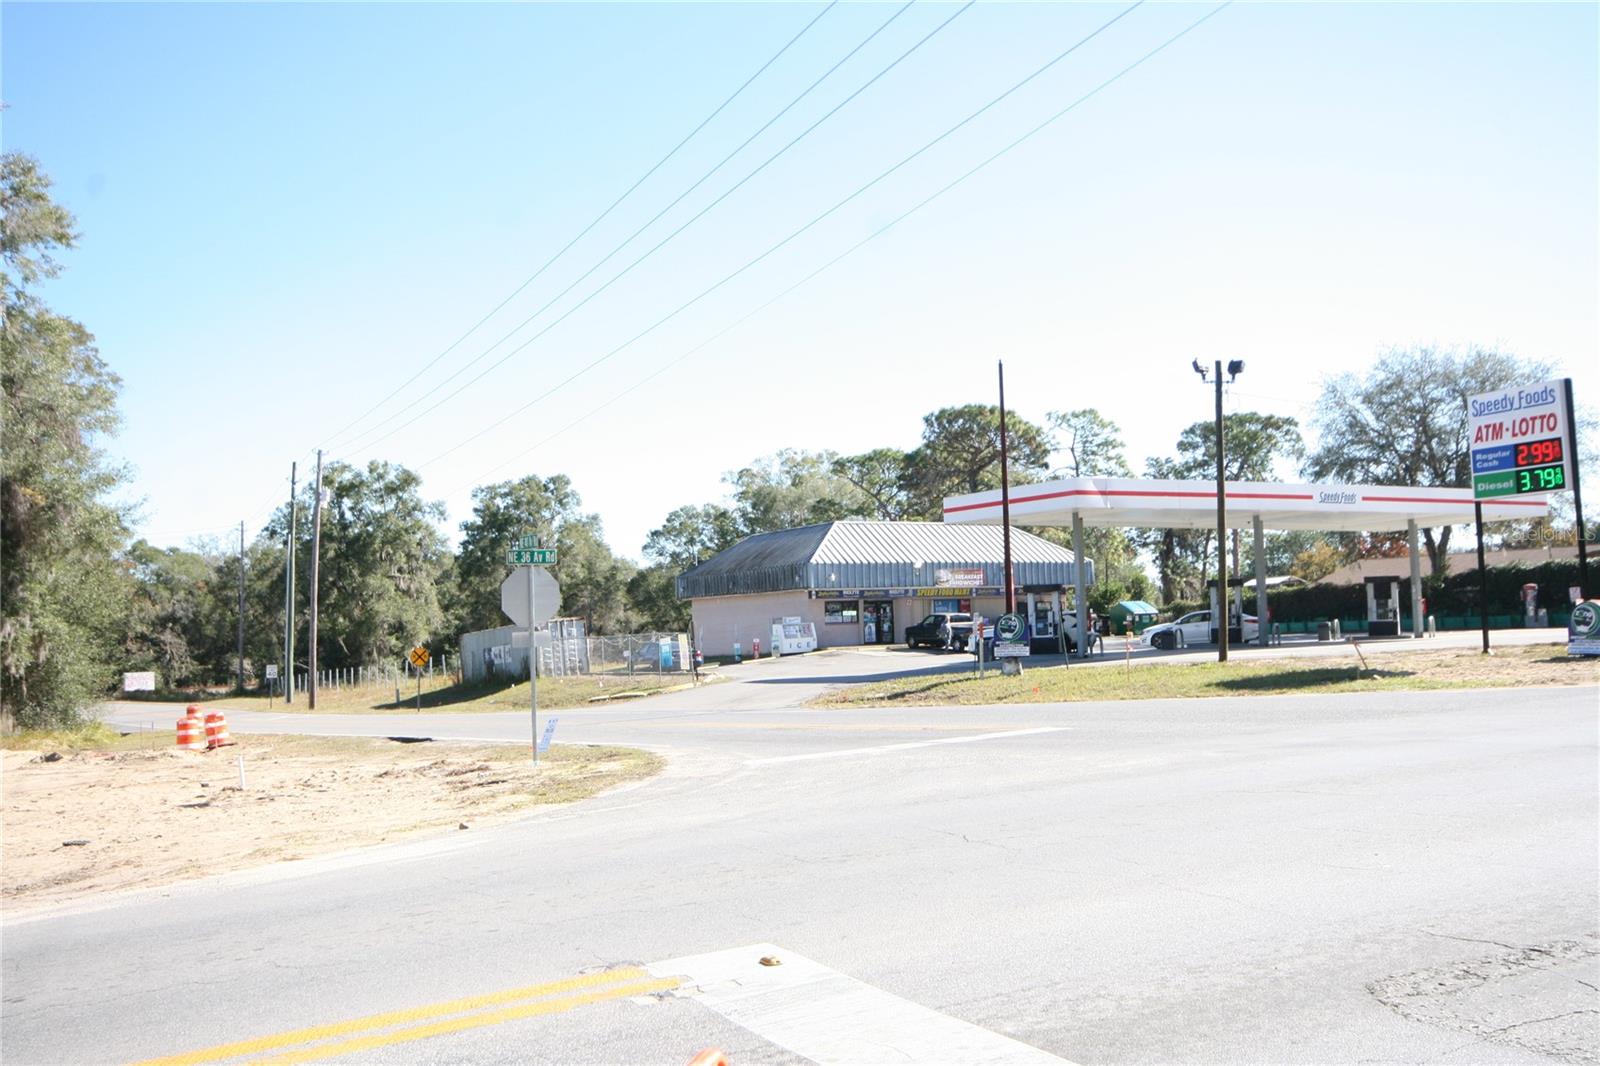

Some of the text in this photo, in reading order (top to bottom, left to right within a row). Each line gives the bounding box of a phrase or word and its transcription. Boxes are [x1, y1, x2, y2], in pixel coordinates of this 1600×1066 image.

[1471, 386, 1556, 417] Speedy Foods
[1474, 413, 1557, 443] ATM LOTTO
[1475, 450, 1511, 460] Regular
[1476, 460, 1499, 469] Cash
[1477, 479, 1514, 491] Diesel
[1319, 491, 1357, 504] Speedy Foods
[508, 551, 518, 563] NE
[520, 551, 531, 563] 36
[545, 551, 555, 563] Rd
